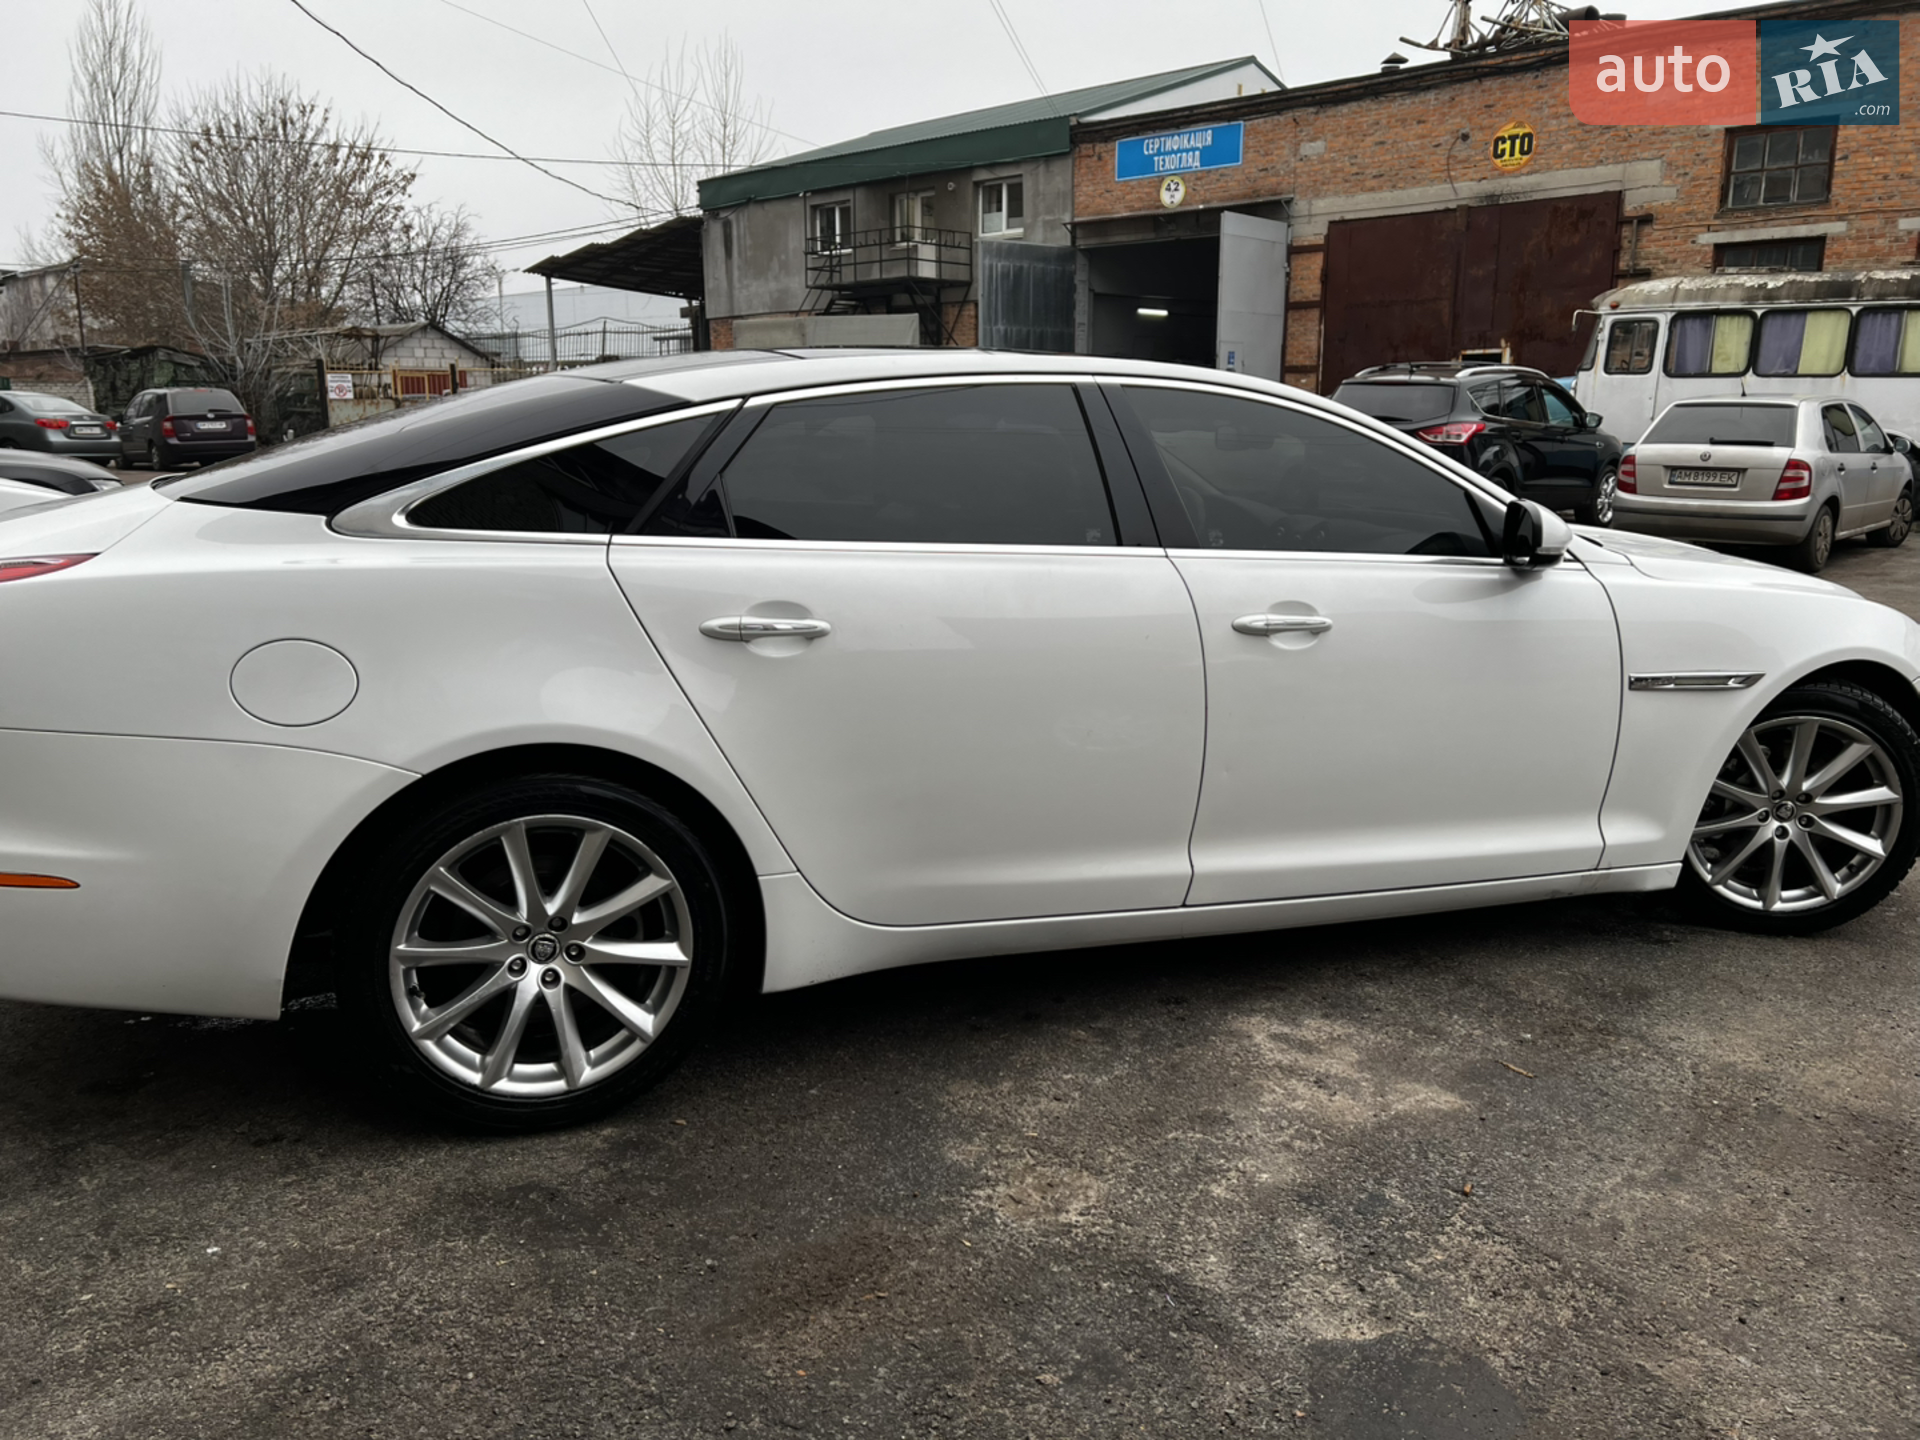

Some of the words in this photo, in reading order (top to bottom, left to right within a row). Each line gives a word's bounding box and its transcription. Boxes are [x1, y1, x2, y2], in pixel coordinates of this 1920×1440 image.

[1143, 130, 1212, 155] СЕРТИФІКАЦІЯ
[1493, 132, 1534, 159] СТО
[1153, 151, 1200, 172] ТЕХОГЛЯД
[1693, 471, 1718, 482] 8199
[1719, 472, 1737, 483] EK
